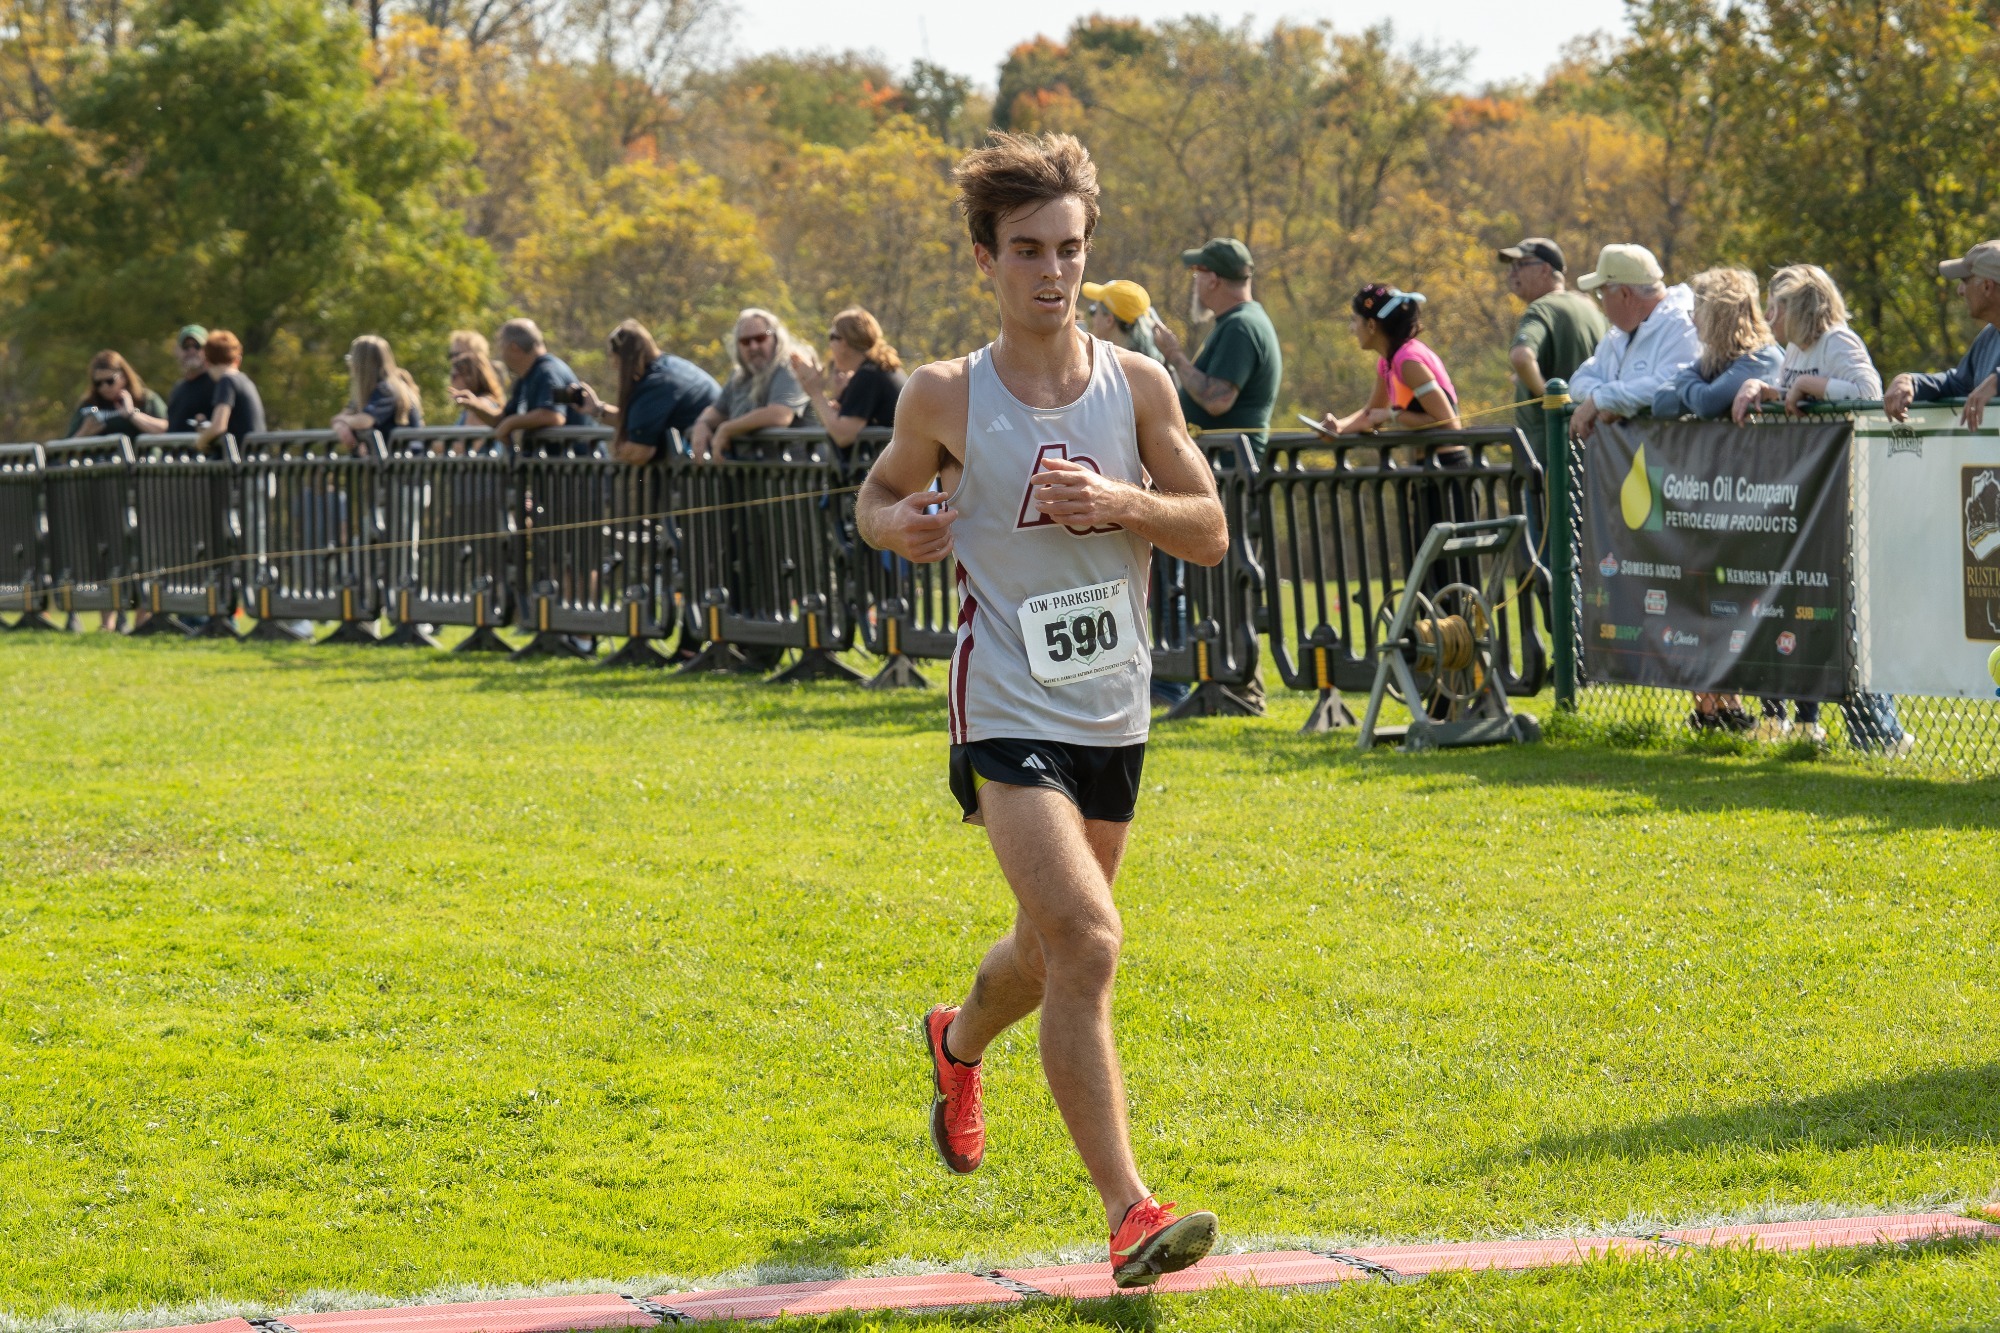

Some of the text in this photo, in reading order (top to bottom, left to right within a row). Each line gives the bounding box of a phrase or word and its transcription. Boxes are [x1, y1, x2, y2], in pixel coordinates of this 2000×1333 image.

[1663, 473, 1799, 511] Golden Oil Company
[1665, 510, 1798, 534] PETROLEUM PRODUCTS
[1726, 567, 1768, 586] KENOSHA
[1796, 570, 1829, 587] PLAZA
[1966, 566, 2000, 587] RUSTI
[1029, 583, 1120, 614] UW-PARKSIDE XC
[1795, 606, 1838, 620] SUBWAY
[1044, 610, 1119, 662] 590
